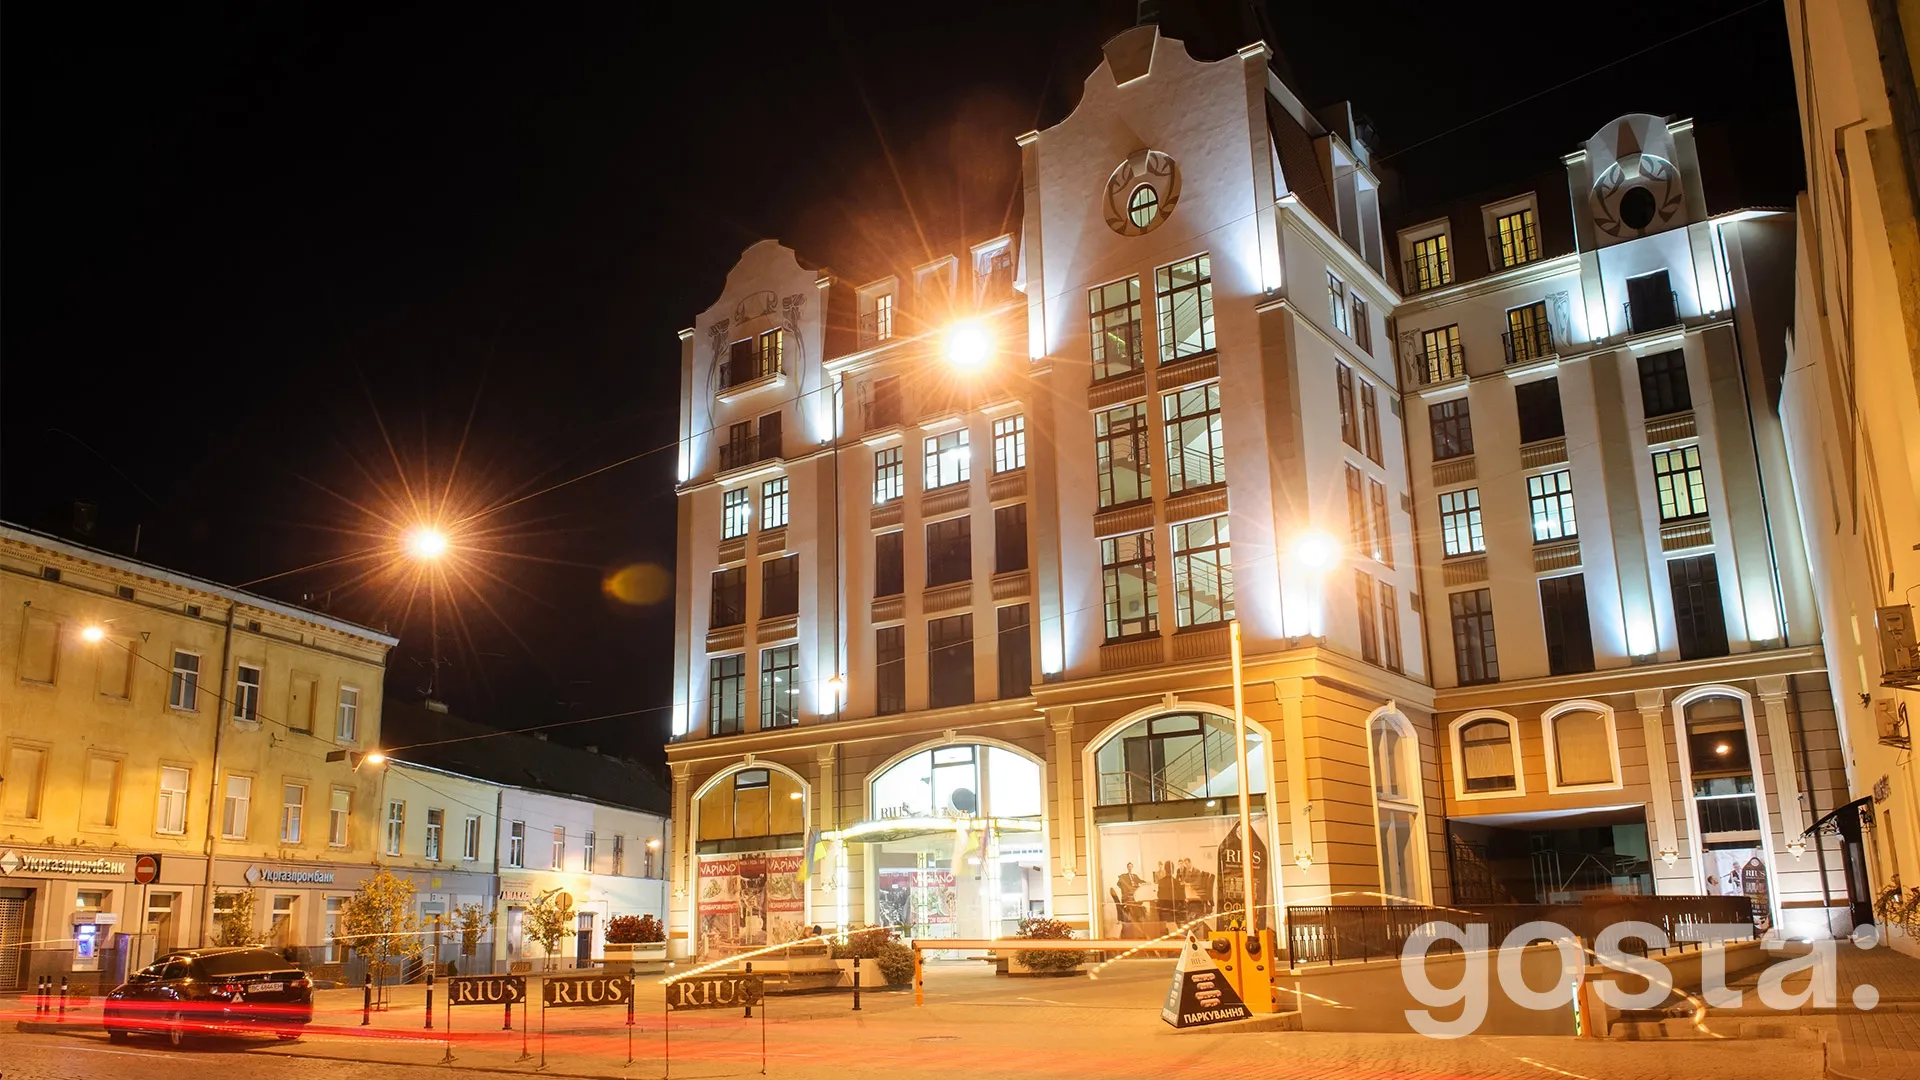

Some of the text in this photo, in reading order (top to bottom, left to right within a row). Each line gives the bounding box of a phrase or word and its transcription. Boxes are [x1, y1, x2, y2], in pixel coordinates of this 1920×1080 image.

[22, 855, 126, 876] Укргазпромбанк
[1225, 849, 1262, 864] RIS
[261, 868, 335, 884] Укргазпромбанк
[553, 978, 622, 1003] RIUS
[1183, 1006, 1245, 1024] ПАРКУВАННЯ
